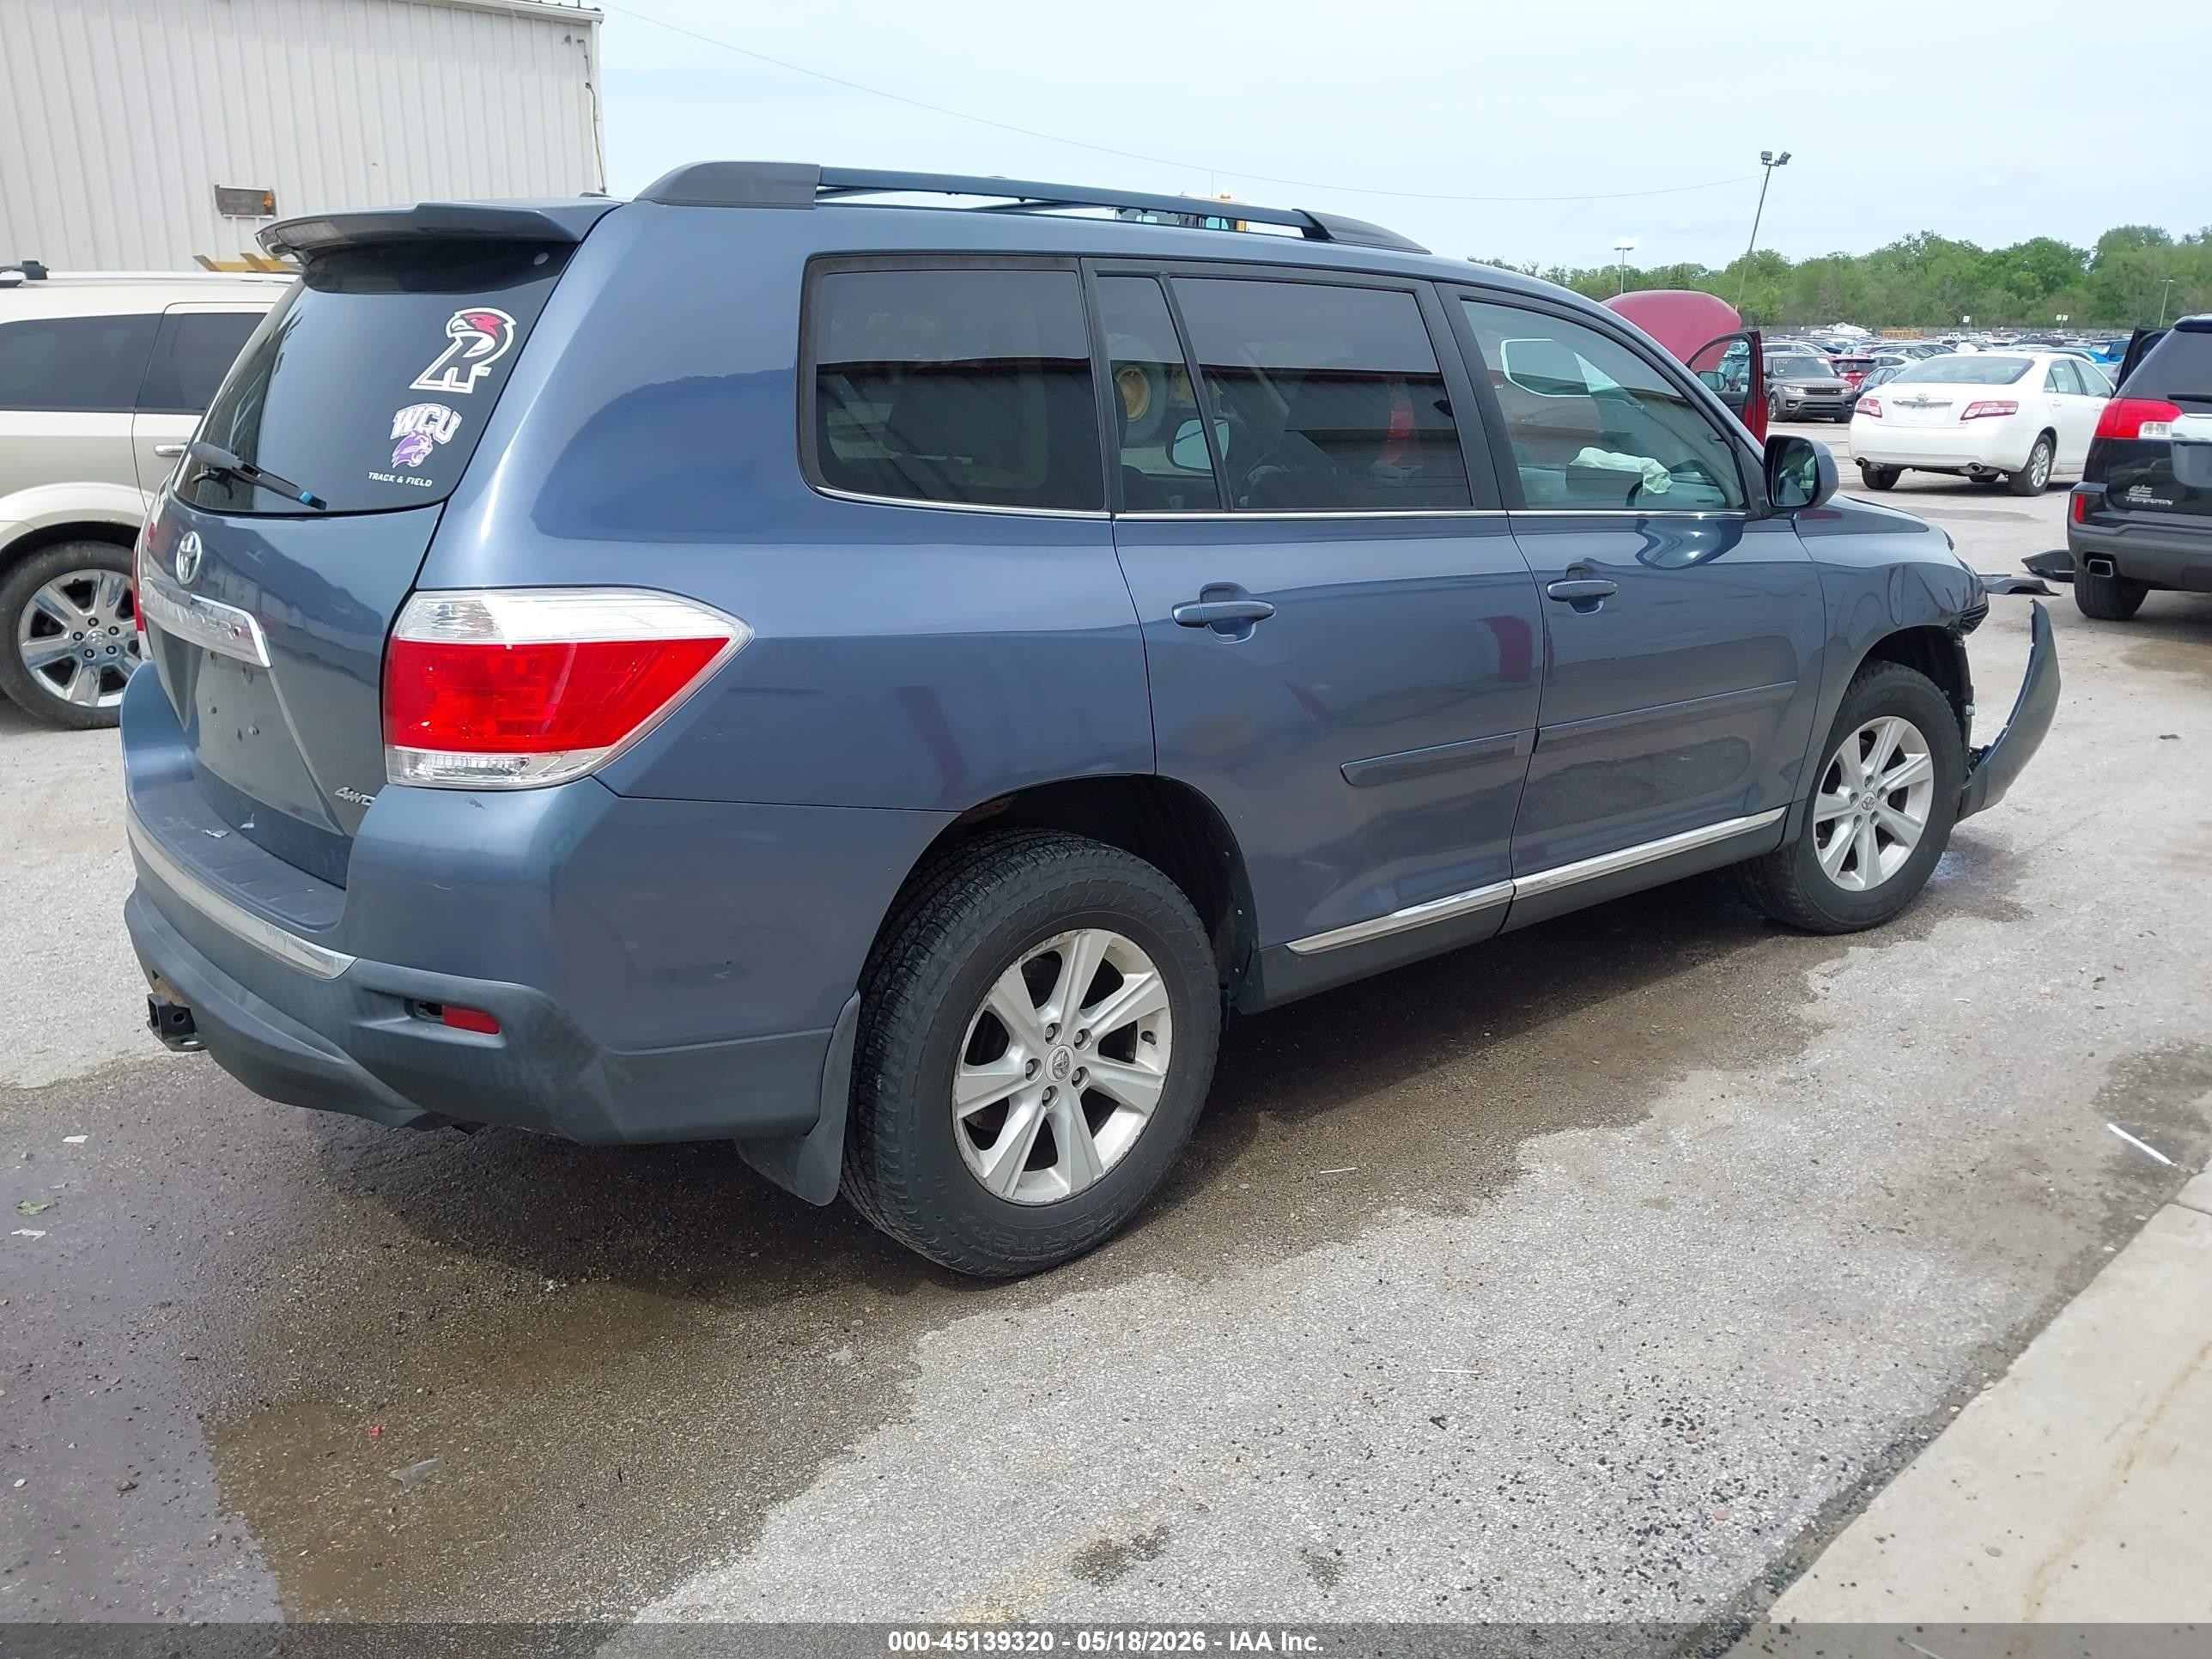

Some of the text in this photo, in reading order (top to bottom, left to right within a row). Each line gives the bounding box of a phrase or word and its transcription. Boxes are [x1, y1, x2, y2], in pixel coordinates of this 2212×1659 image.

[390, 403, 463, 445] WCU
[368, 471, 395, 482] TRACK
[405, 477, 433, 487] FIELD
